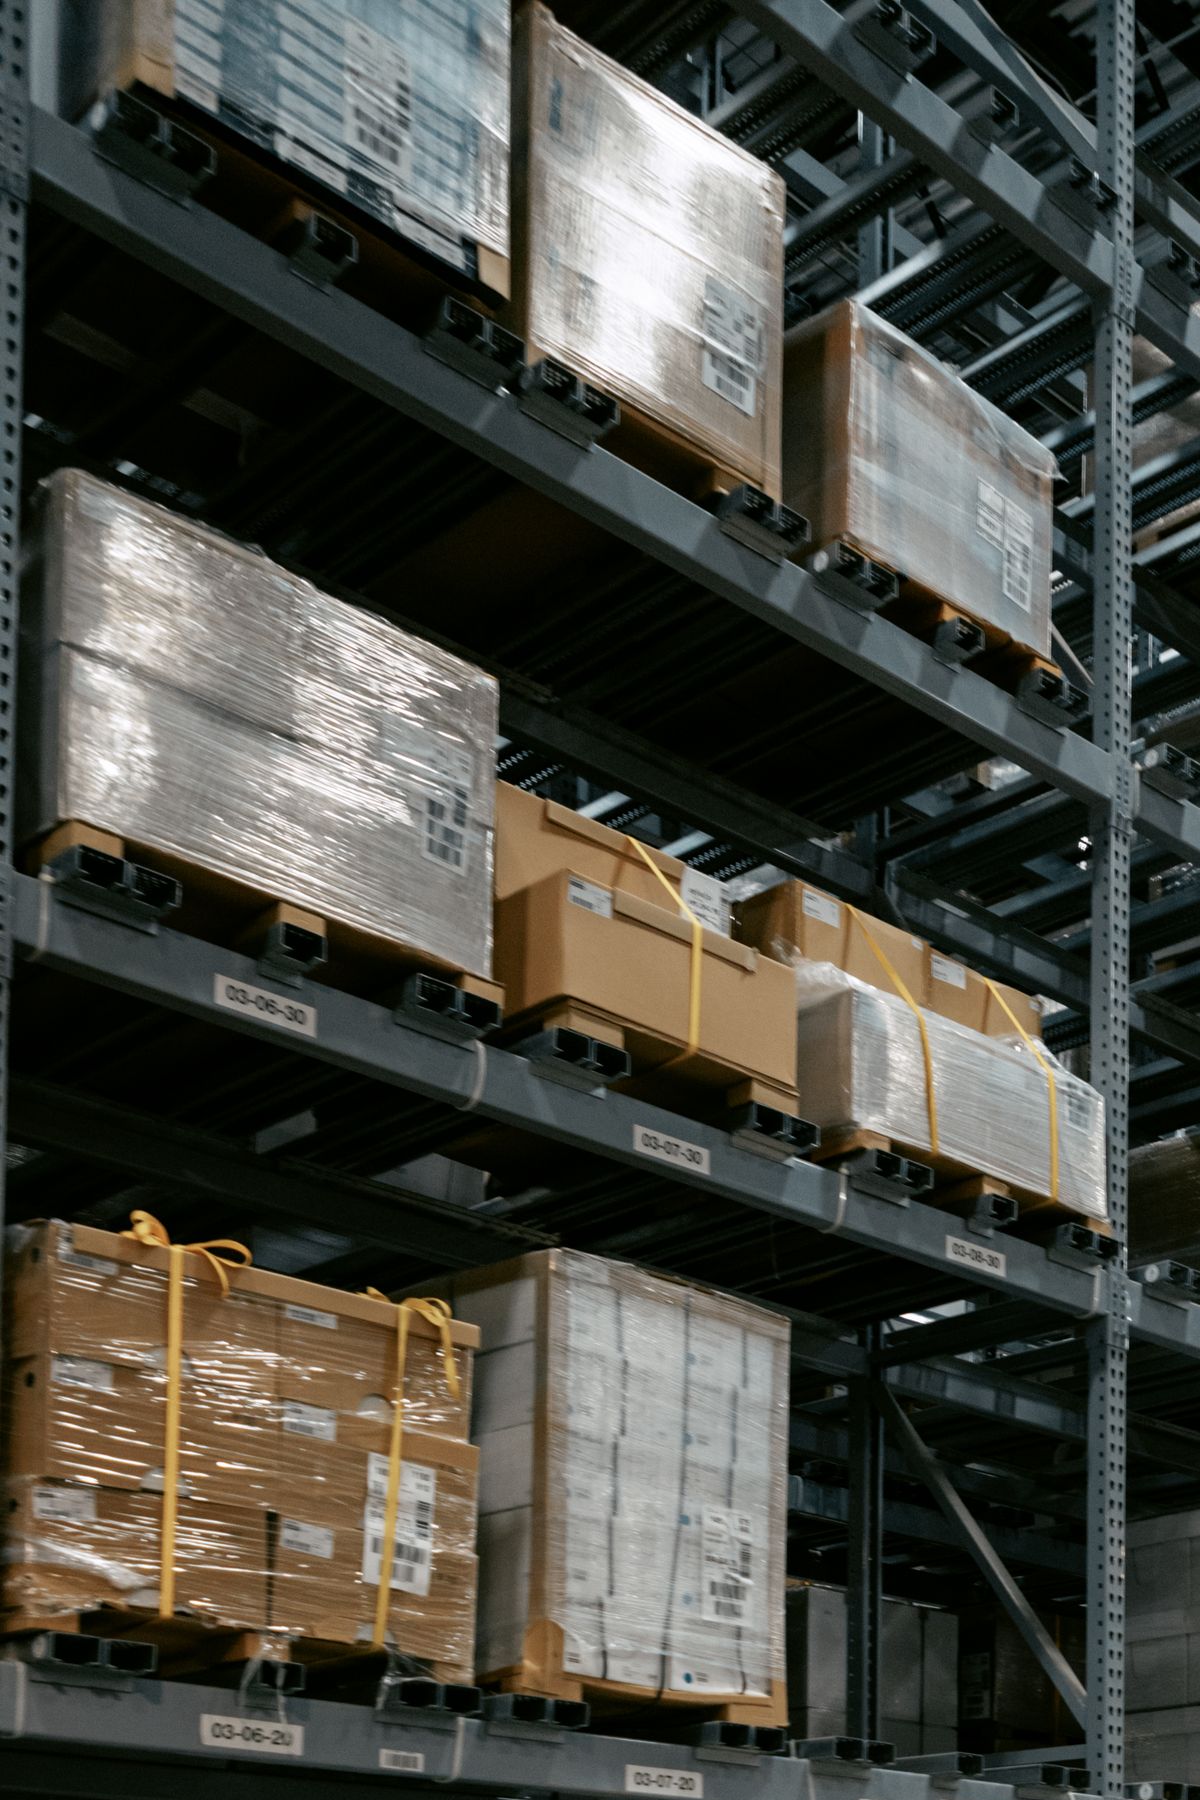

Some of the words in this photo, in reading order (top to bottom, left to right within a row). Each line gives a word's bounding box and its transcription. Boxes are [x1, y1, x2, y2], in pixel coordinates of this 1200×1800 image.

[225, 984, 307, 1025] 03-06-30
[641, 1133, 703, 1165] 03-07-30
[211, 1722, 293, 1746] 03-06-20
[634, 1772, 695, 1790] 03-07-20
